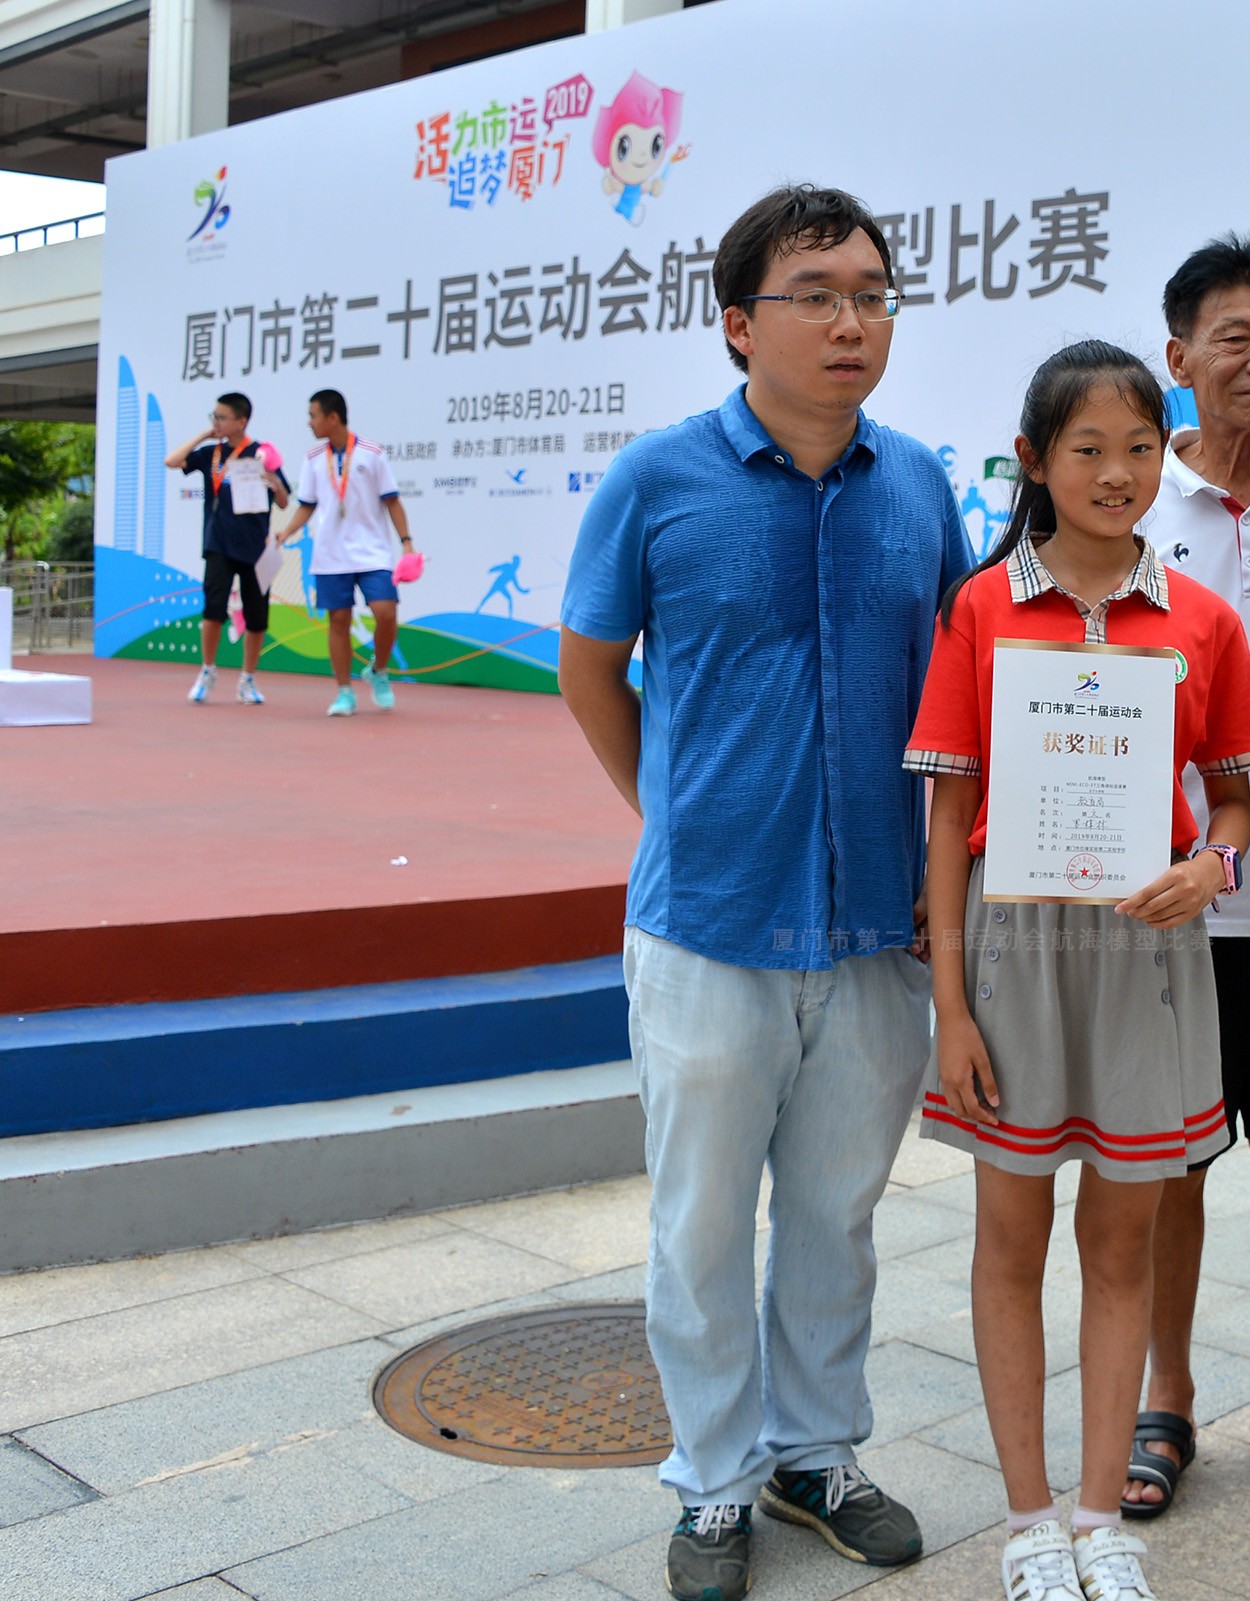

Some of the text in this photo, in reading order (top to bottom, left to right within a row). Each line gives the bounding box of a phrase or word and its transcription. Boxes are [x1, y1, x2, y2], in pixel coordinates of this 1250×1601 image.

[548, 82, 590, 119] 2019
[414, 97, 537, 183] 活力市运
[449, 134, 571, 210] 追梦厦门
[180, 187, 1110, 382] 厦门市第二十届运动会航型比赛
[446, 382, 626, 424] 2019年8月20-21日
[1028, 701, 1143, 719] 厦门市第二十届运动会
[1042, 731, 1130, 757] 获奖证书
